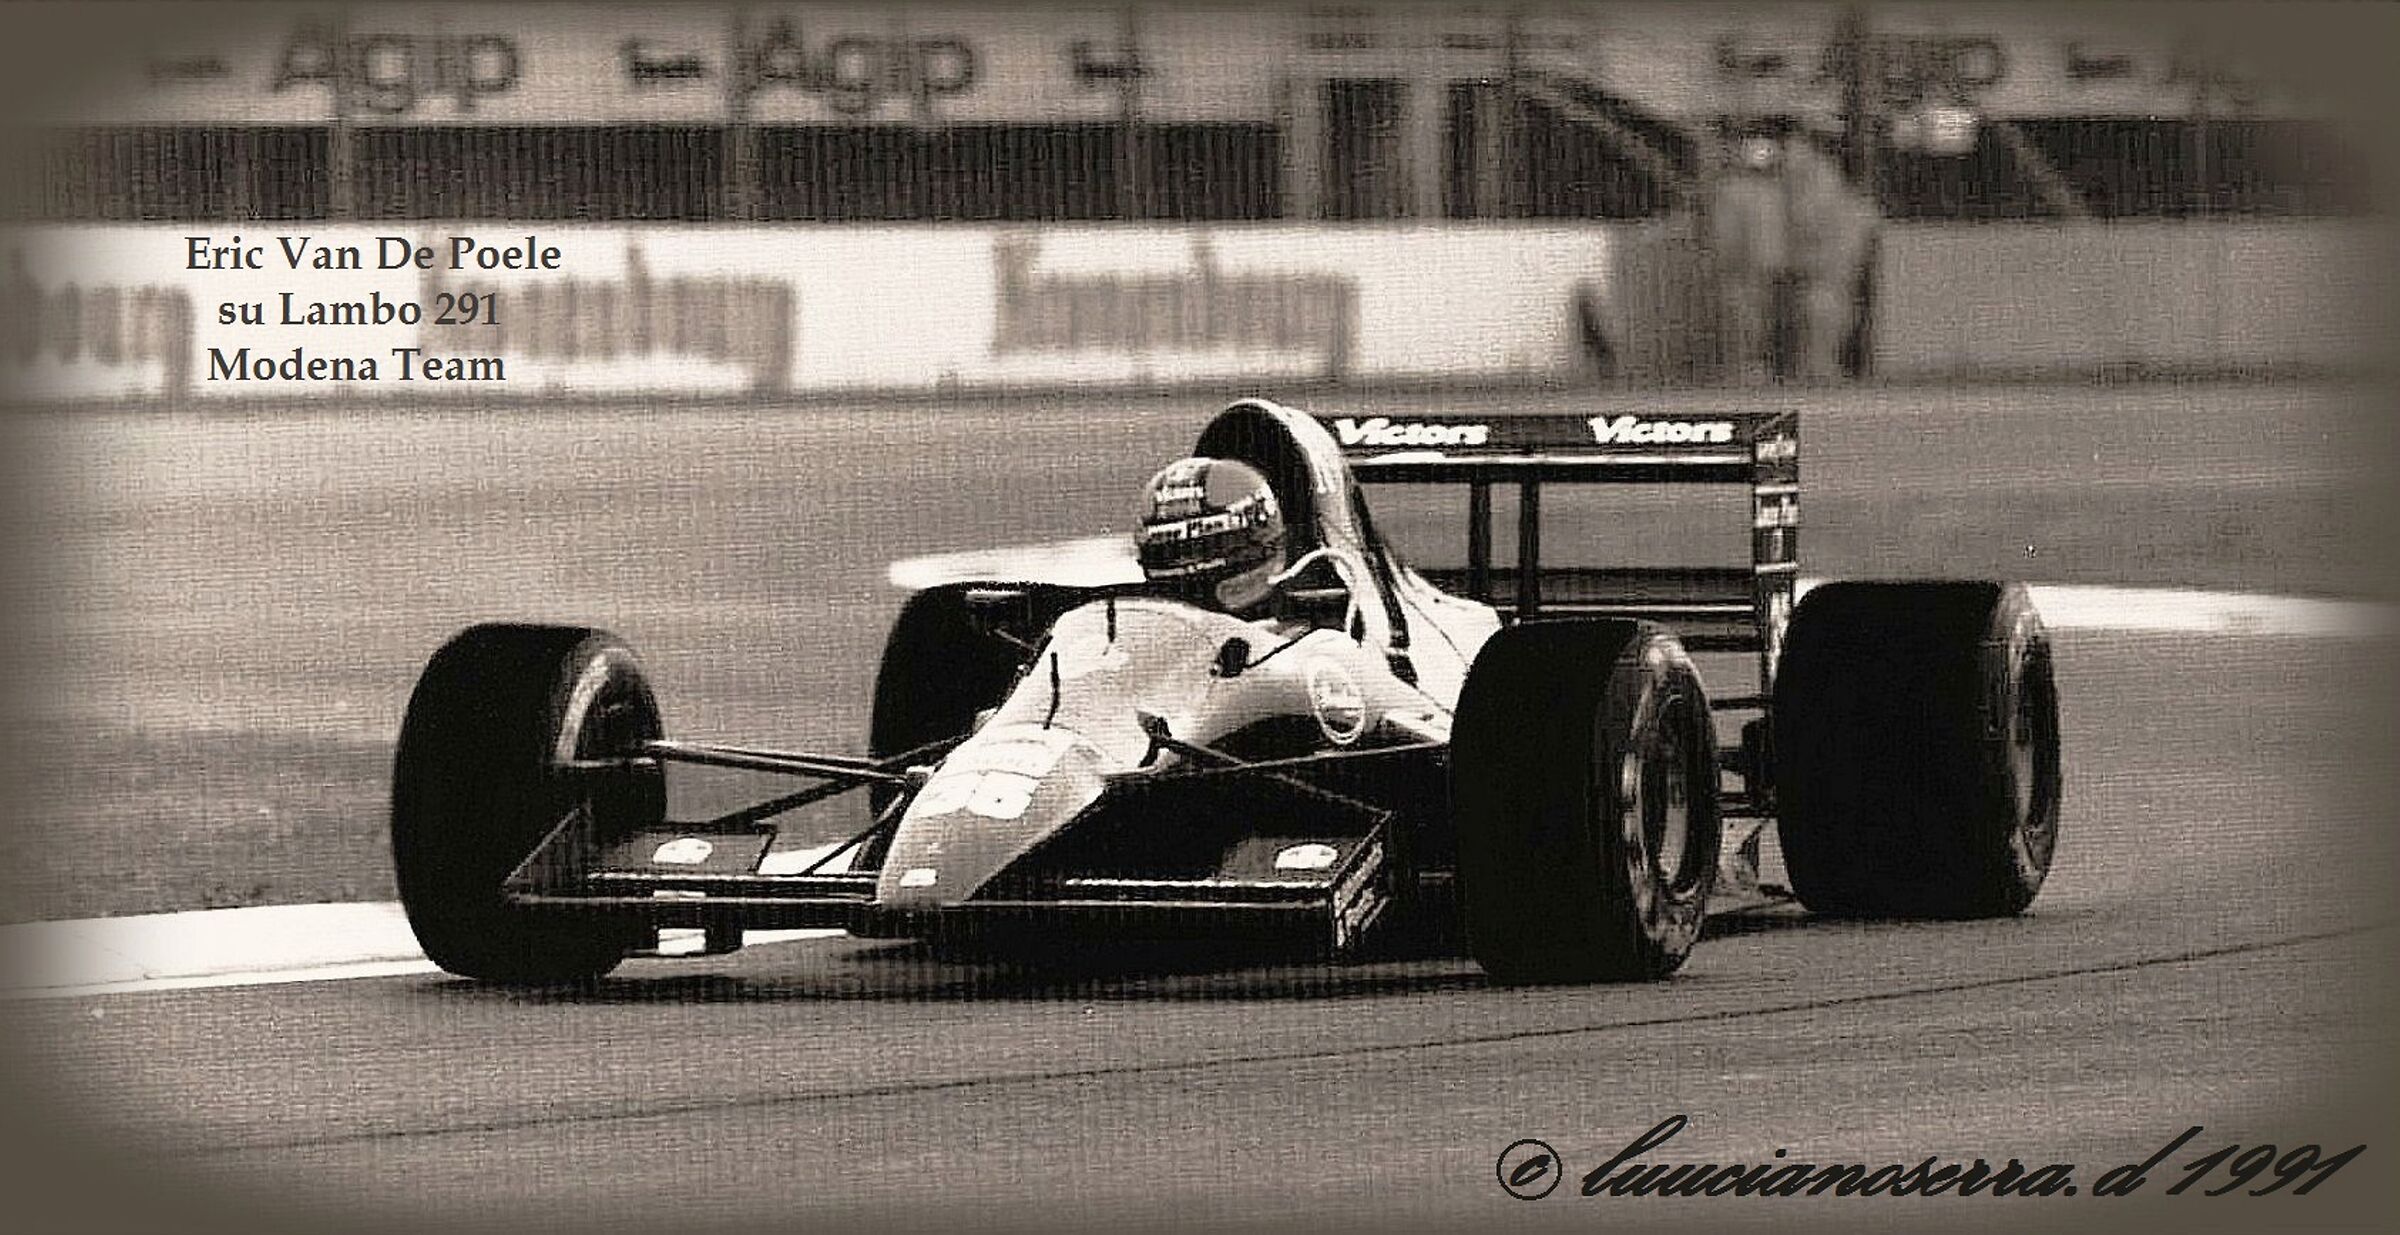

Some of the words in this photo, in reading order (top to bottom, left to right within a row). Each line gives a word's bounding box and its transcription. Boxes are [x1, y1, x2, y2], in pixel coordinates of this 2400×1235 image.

[272, 20, 520, 114] Agip
[748, 18, 976, 115] Agip
[1334, 416, 1489, 445] Victors
[1588, 415, 1734, 443] Victors
